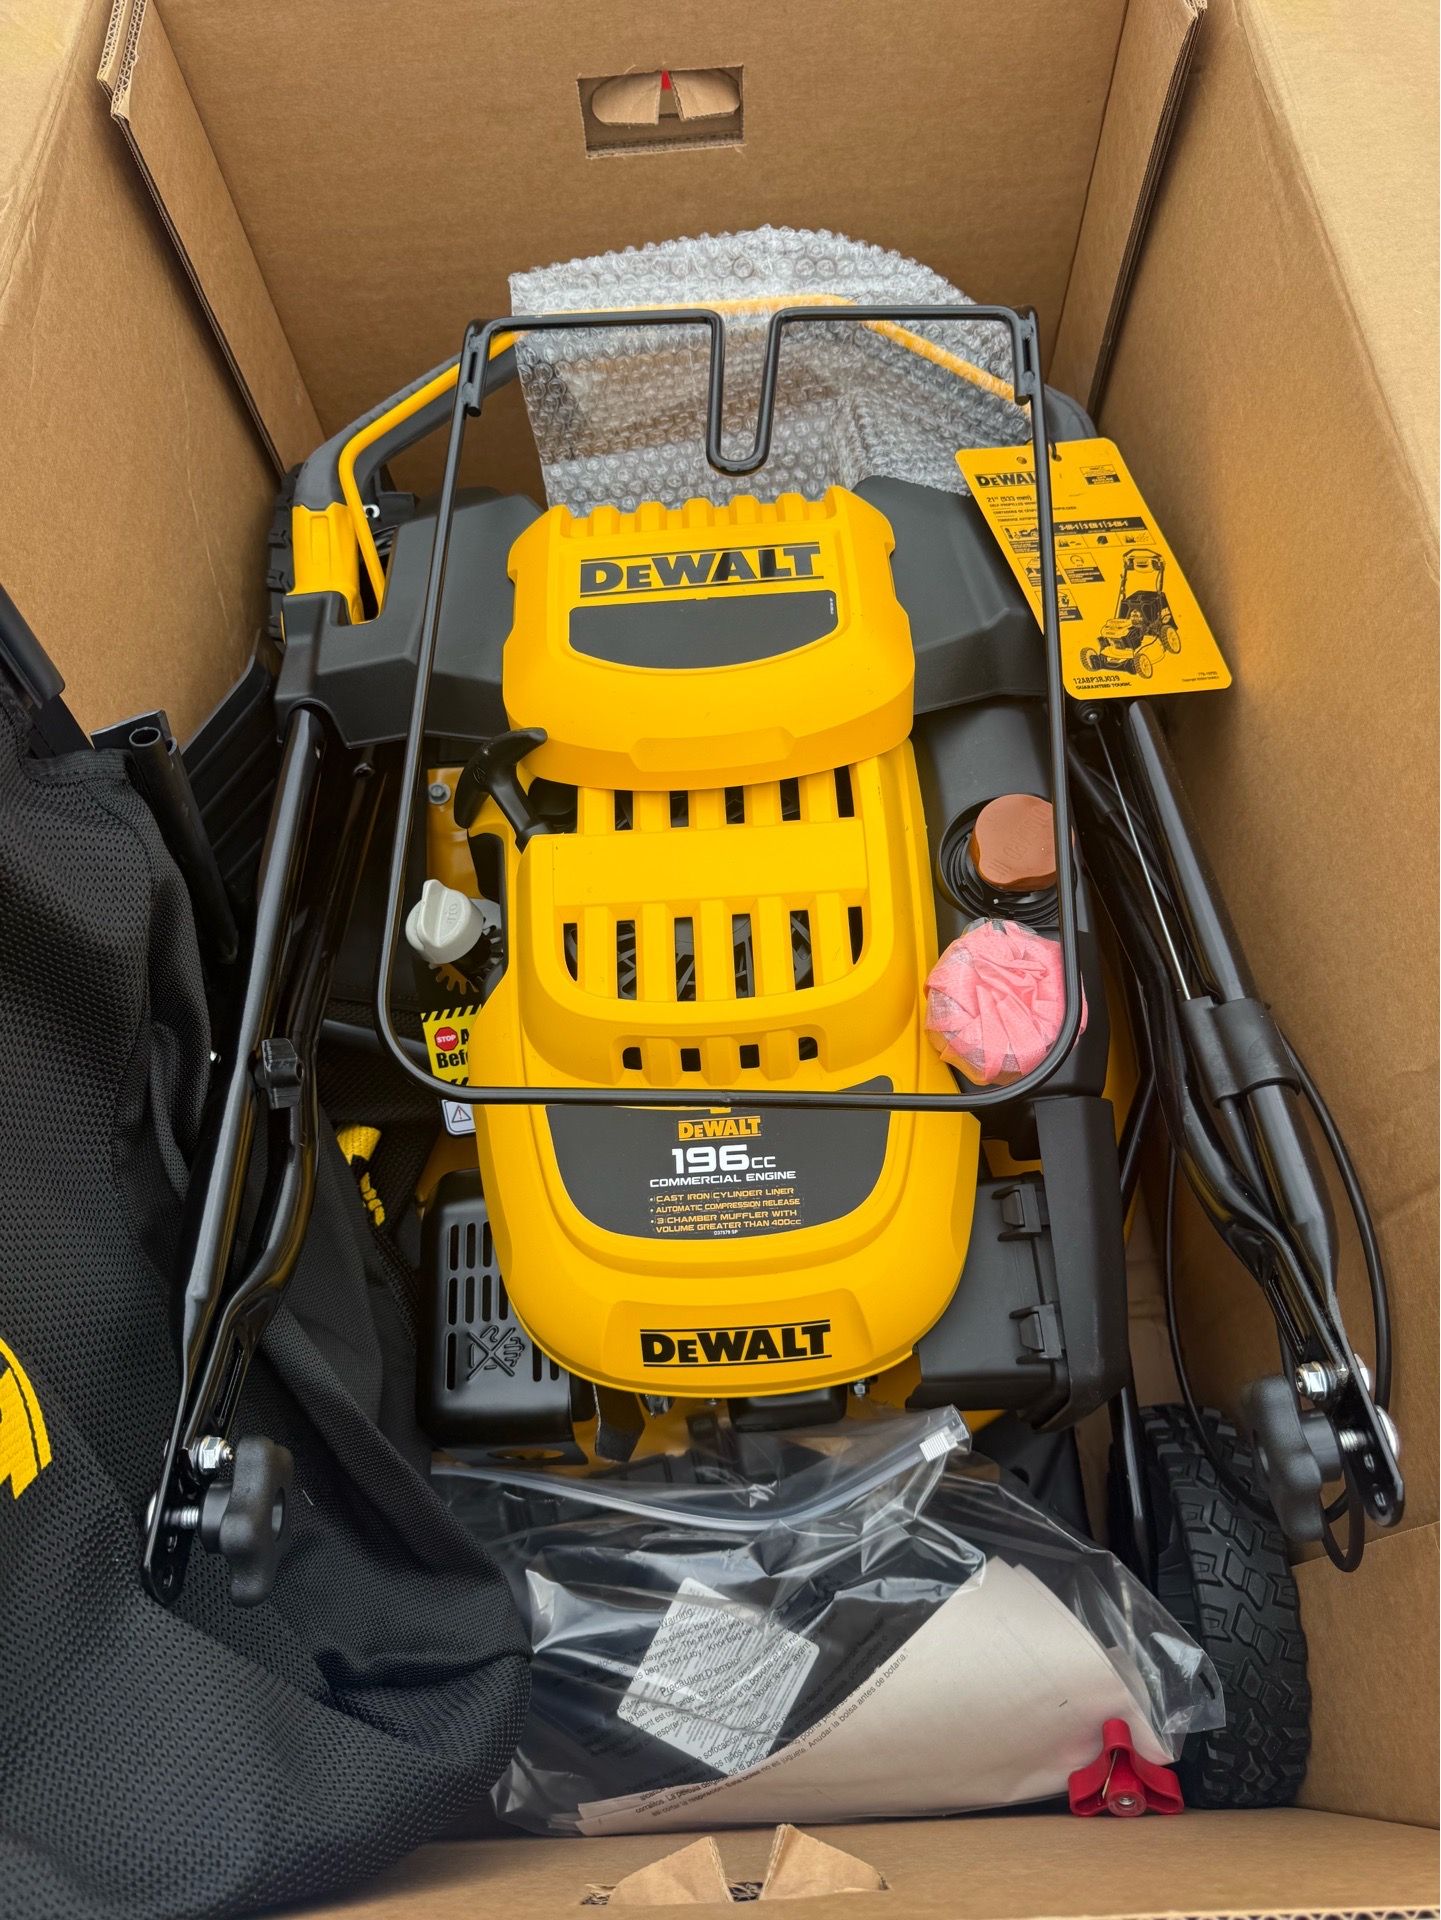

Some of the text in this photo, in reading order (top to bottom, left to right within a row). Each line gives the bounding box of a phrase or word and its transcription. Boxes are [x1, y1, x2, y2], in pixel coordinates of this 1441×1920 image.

[975, 471, 1036, 489] DEWAL
[580, 545, 821, 594] DEWALT
[436, 1034, 457, 1044] STOP
[436, 1049, 469, 1069] Bef
[678, 1116, 762, 1140] DEWALT
[649, 1170, 797, 1188] COMMERCIAL ENGINE
[656, 1187, 794, 1203] CAST IRON CYLINDER LINER
[655, 1198, 801, 1214] AUTOMATIC COMPRESSION RELEASE
[656, 1209, 798, 1225] 3 CHAMBER MUFFLER WITH
[655, 1224, 695, 1234] VOLUME
[696, 1221, 742, 1231] GREATER
[743, 1219, 770, 1228] THAN
[640, 1322, 833, 1364] DEWALT
[808, 1726, 833, 1748] Anudar
[855, 1685, 876, 1705] antes
[873, 1675, 885, 1687] de
